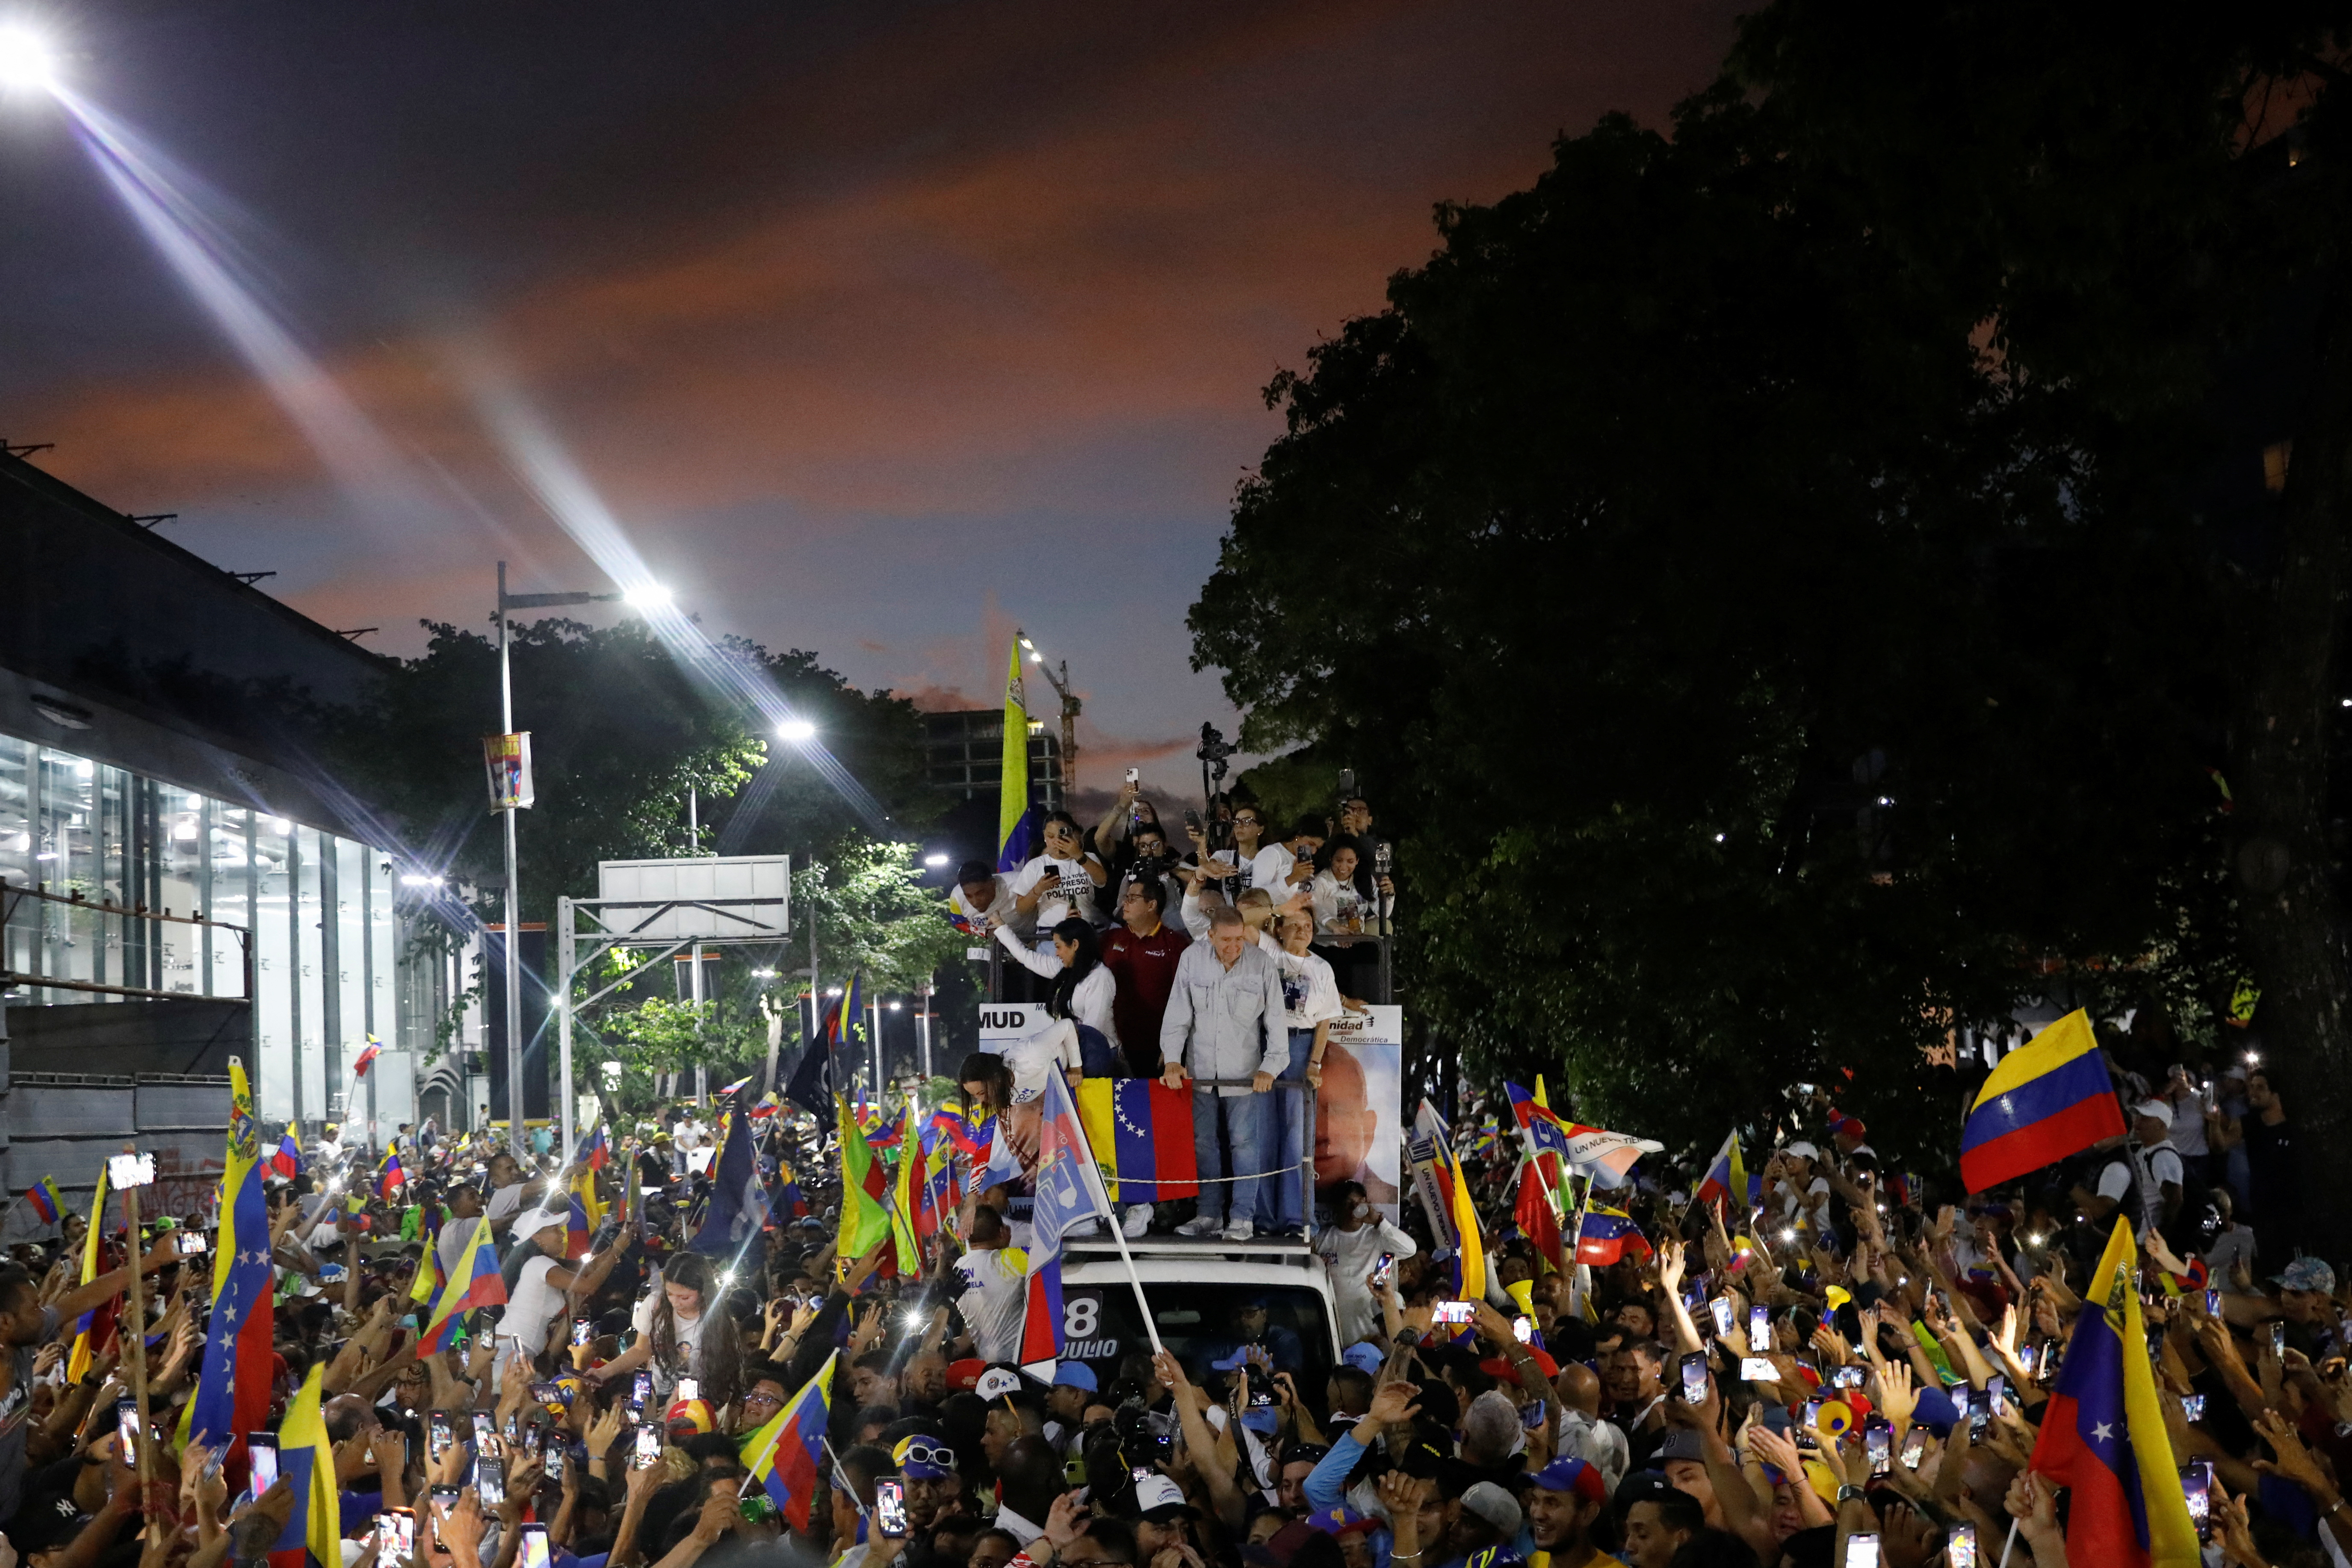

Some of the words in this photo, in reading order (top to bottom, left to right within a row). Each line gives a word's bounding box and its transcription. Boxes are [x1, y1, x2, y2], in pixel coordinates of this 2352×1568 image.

[979, 1012, 1025, 1028] MUD
[1329, 1020, 1363, 1030] nidad
[1340, 1035, 1388, 1043] Democrática
[1575, 1143, 1589, 1154] UN
[1422, 1168, 1430, 1181] UN
[1427, 1181, 1440, 1211] NUEVO
[1436, 1213, 1450, 1245] TIEMPO
[1063, 1298, 1099, 1338] 8
[1055, 1339, 1118, 1360] JULIO
